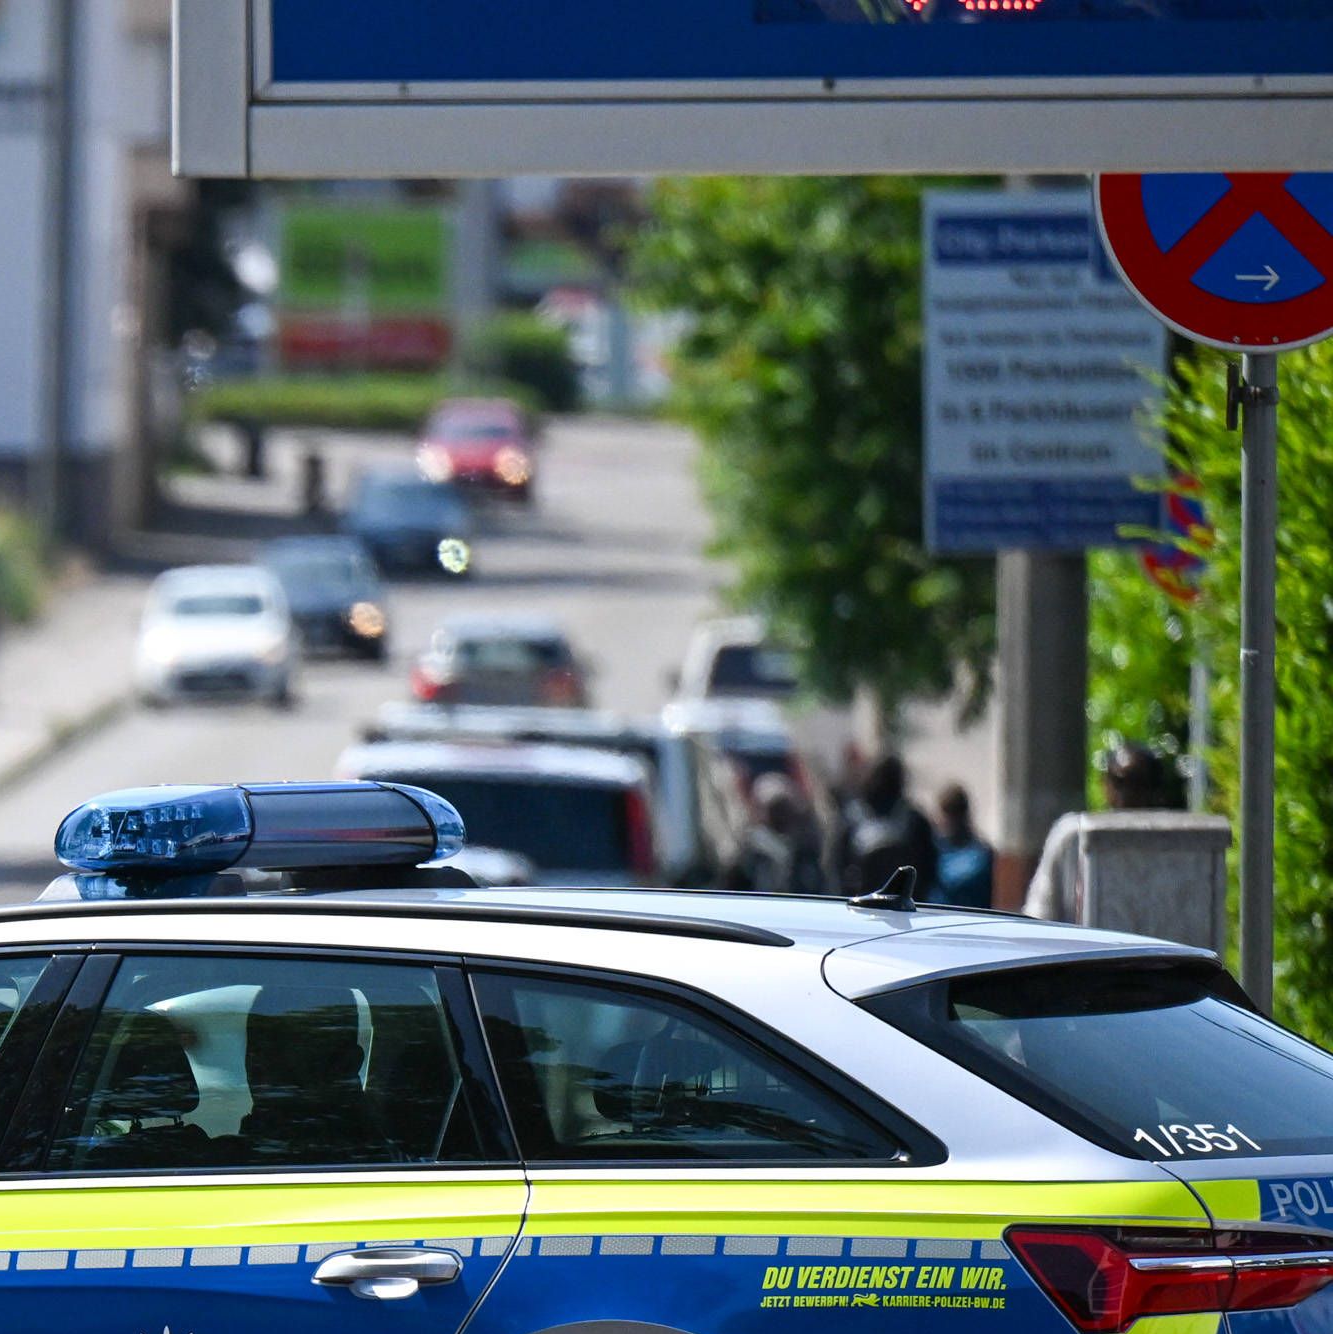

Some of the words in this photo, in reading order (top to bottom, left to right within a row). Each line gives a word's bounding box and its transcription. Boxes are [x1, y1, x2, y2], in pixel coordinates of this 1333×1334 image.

[1134, 1123, 1261, 1157] 1/351
[1269, 1180, 1333, 1217] POL
[762, 1266, 796, 1290] DU
[797, 1266, 914, 1290] VERDIENST
[916, 1266, 956, 1290] EIN
[960, 1267, 1007, 1290] WIR.
[760, 1295, 791, 1308] JETZT
[882, 1295, 1005, 1310] KARRIERE-POLIZEI-BW.DE
